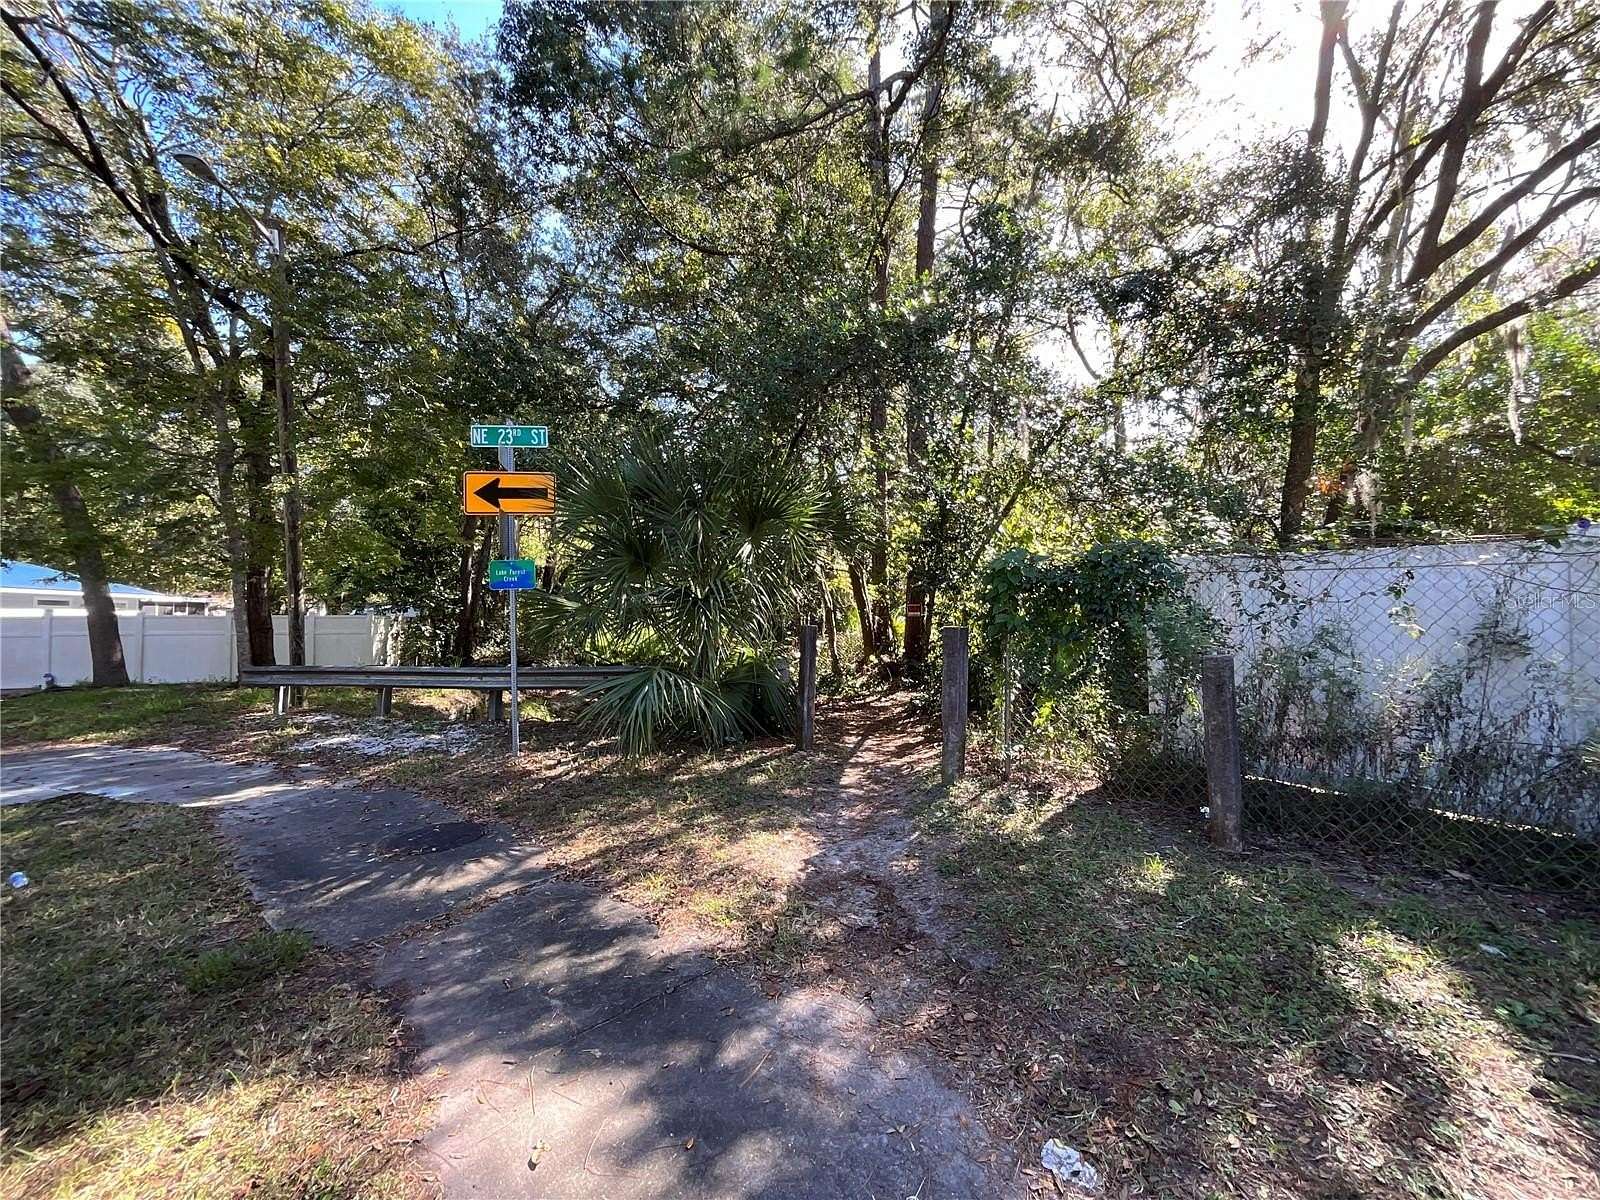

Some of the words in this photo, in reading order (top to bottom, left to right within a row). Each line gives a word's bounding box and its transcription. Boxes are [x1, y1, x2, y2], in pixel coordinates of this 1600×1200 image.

[473, 428, 488, 444] NE
[498, 428, 521, 444] 23RD
[531, 429, 545, 445] ST
